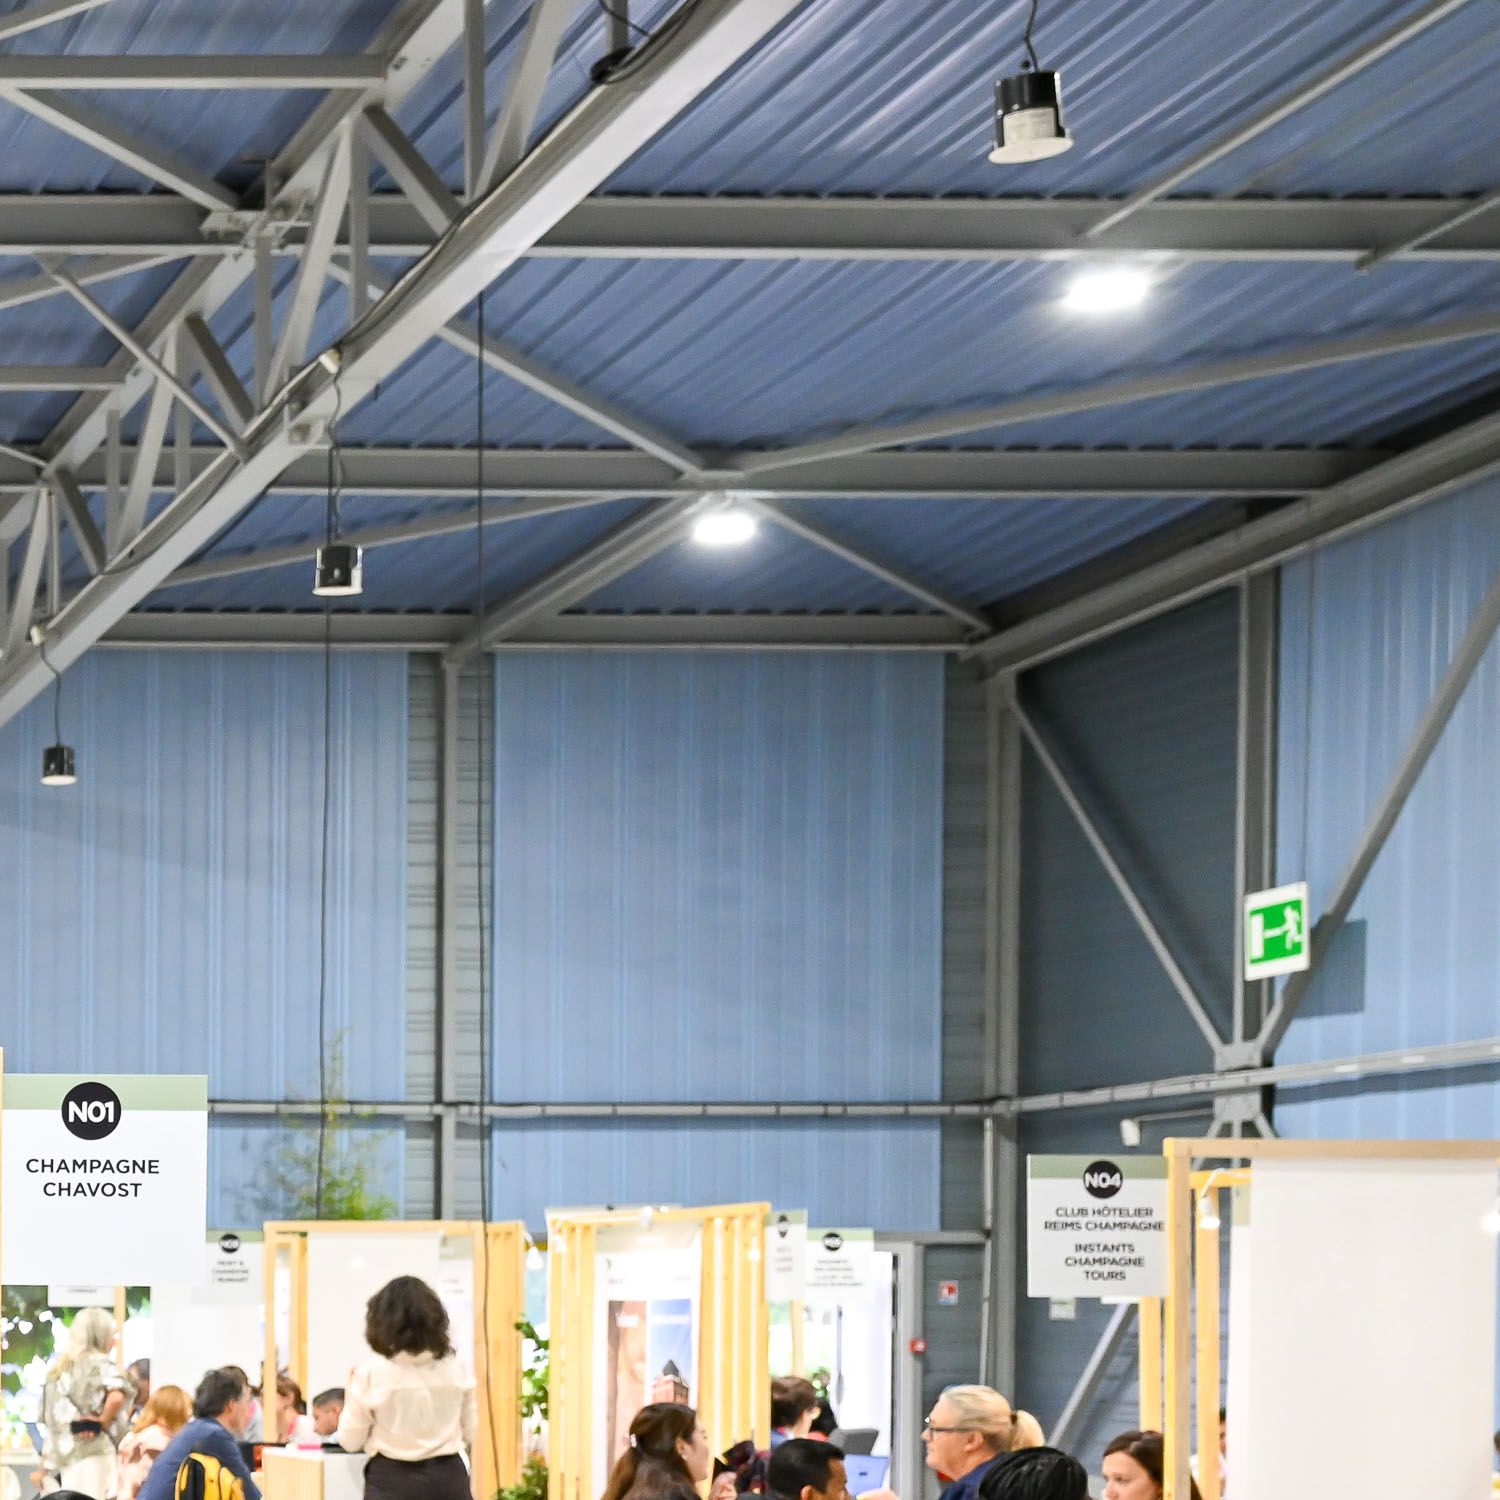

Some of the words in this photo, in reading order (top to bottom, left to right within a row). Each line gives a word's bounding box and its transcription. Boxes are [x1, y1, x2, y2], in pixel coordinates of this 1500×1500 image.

[68, 1100, 115, 1123] N01
[26, 1158, 160, 1174] CHAMPAGNE
[1084, 1171, 1121, 1189] N04
[43, 1182, 142, 1197] CHAVOST
[1056, 1206, 1088, 1218] CLUB
[1092, 1205, 1153, 1218] HÔTELIER
[1044, 1221, 1082, 1231] REIMS
[1085, 1221, 1165, 1232] CHAMPAGNE
[1074, 1243, 1135, 1253] INSTANTS
[1064, 1256, 1145, 1267] CHAMPAGNE
[1084, 1269, 1127, 1281] TOURS
